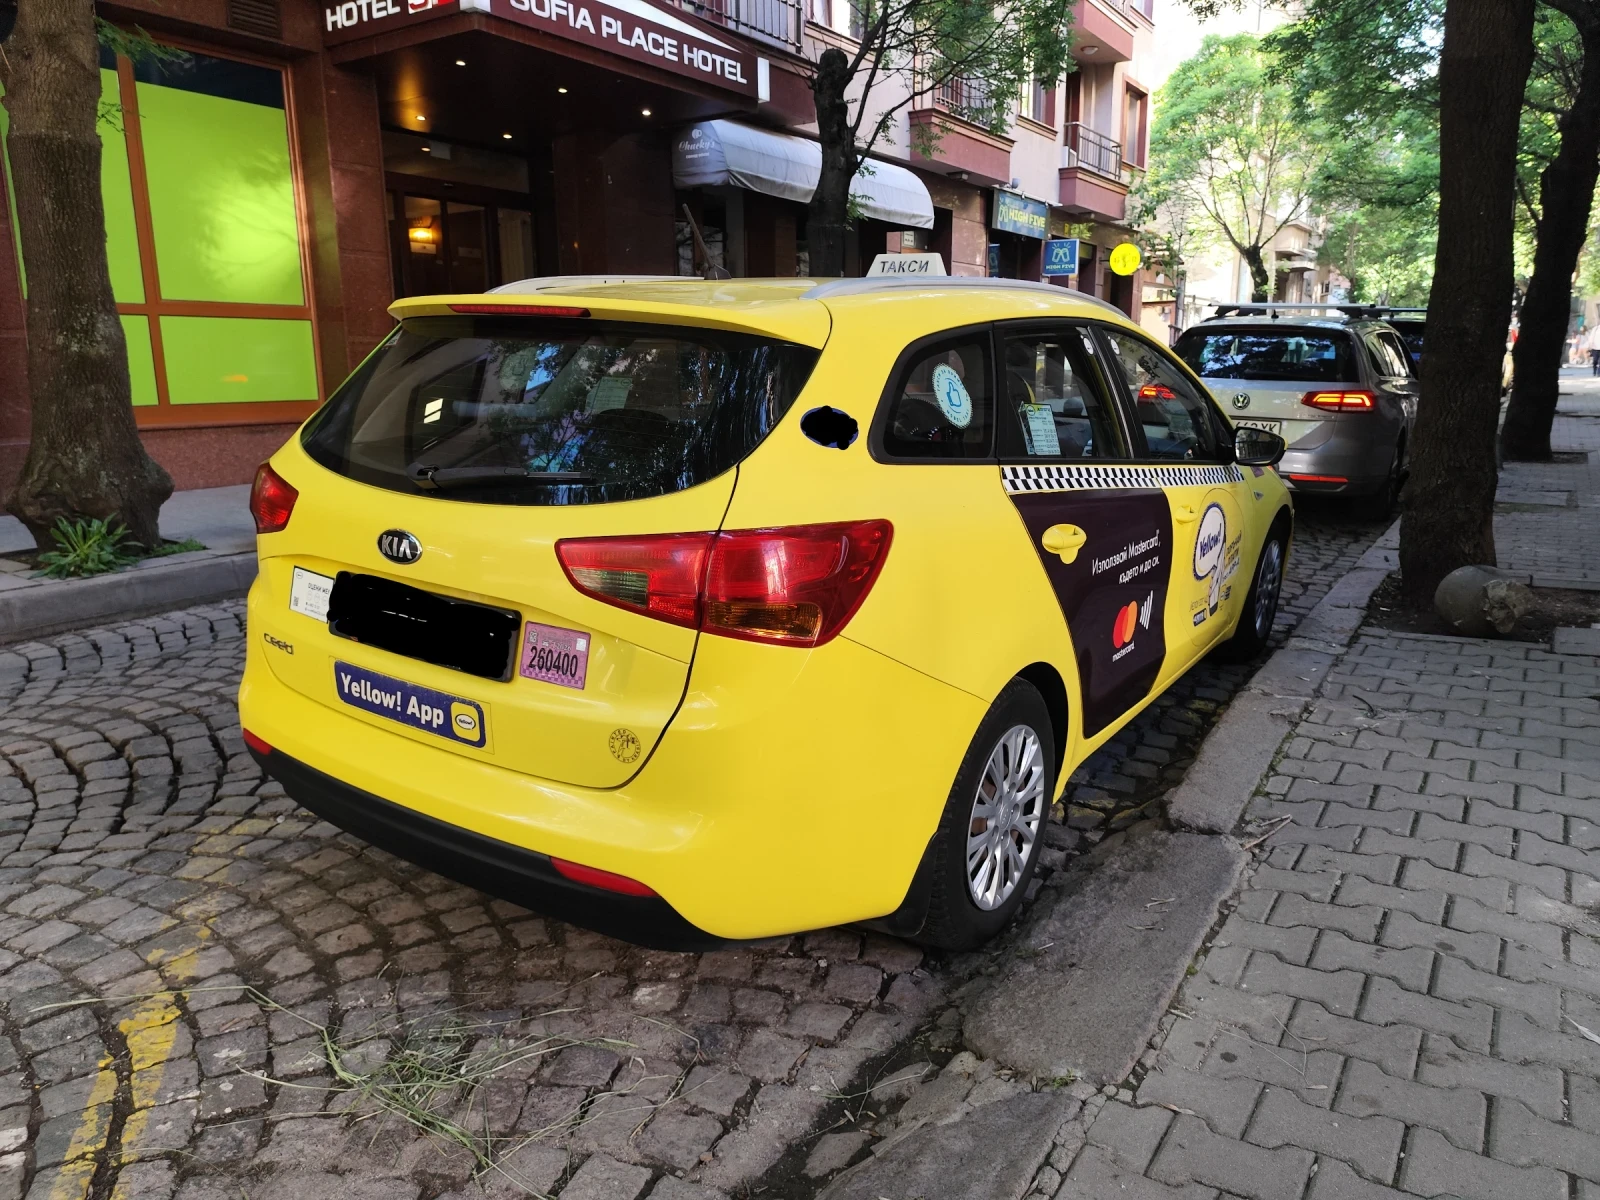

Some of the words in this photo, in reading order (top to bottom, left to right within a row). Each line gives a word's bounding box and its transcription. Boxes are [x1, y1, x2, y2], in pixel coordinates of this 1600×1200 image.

[326, 0, 400, 31] HOTEL
[601, 15, 678, 61] PLACE
[683, 43, 747, 84] HOTEL
[1009, 207, 1029, 223] HIGH
[1029, 213, 1046, 228] FIVE
[880, 260, 929, 273] ТАКСИ
[382, 534, 412, 559] KIA
[1199, 522, 1222, 560] Yellow!
[1092, 546, 1128, 576] Използвай
[1118, 565, 1139, 584] където
[1139, 563, 1144, 573] и
[1144, 559, 1152, 573] да
[528, 646, 578, 678] 260400
[1112, 640, 1135, 662] mastercard
[340, 672, 402, 711] Yellow!
[406, 696, 444, 728] App
